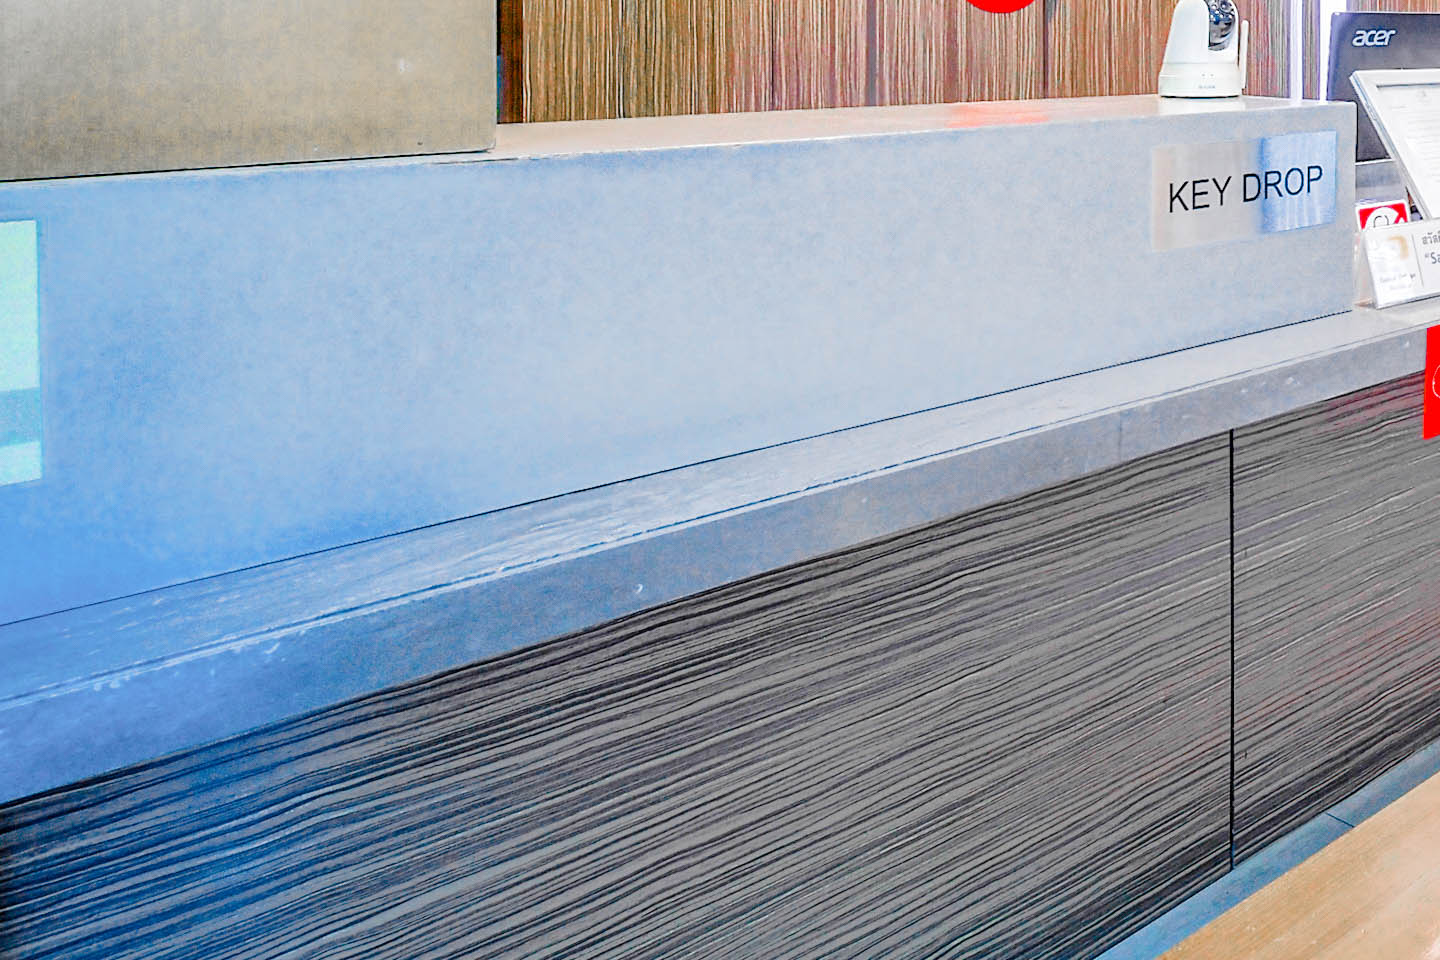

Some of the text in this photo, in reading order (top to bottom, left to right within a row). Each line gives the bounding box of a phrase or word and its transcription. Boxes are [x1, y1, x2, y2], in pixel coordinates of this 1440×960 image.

[1352, 28, 1396, 47] acer
[1169, 165, 1323, 213] KEY DROP
